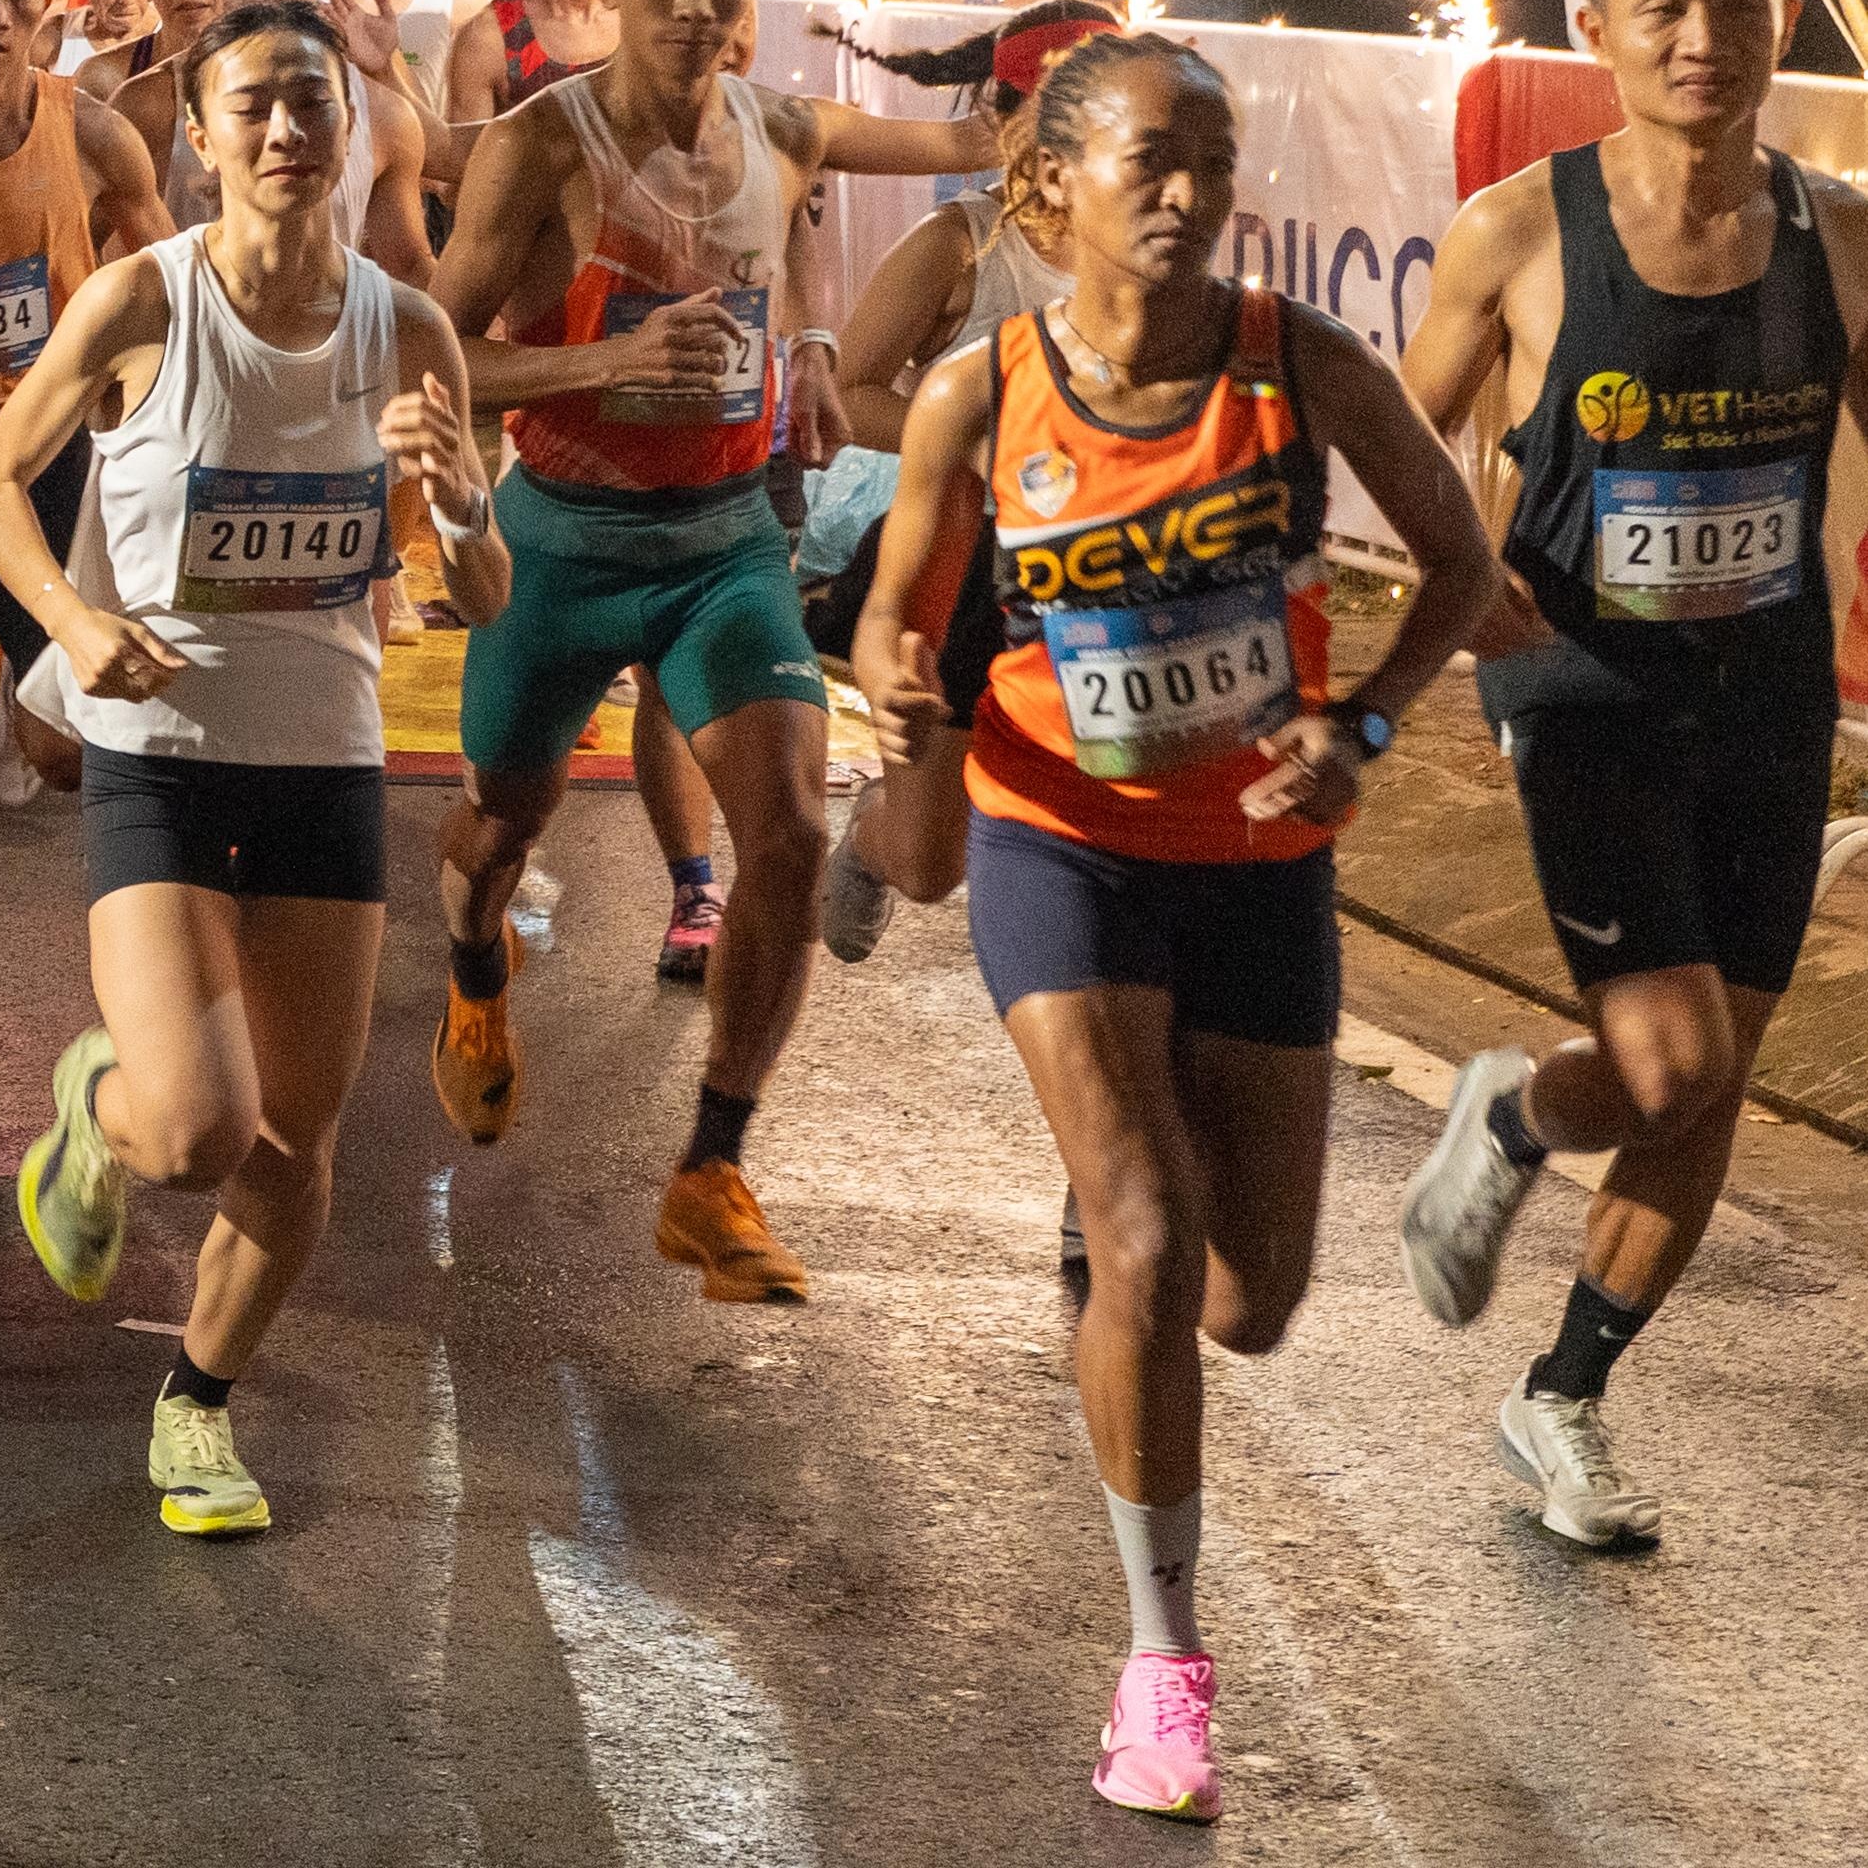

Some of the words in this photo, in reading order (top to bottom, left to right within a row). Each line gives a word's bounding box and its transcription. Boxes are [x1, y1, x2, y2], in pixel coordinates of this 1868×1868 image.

[207, 518, 363, 561] 20140
[1626, 513, 1784, 566] 21023
[1082, 635, 1270, 718] 20064
